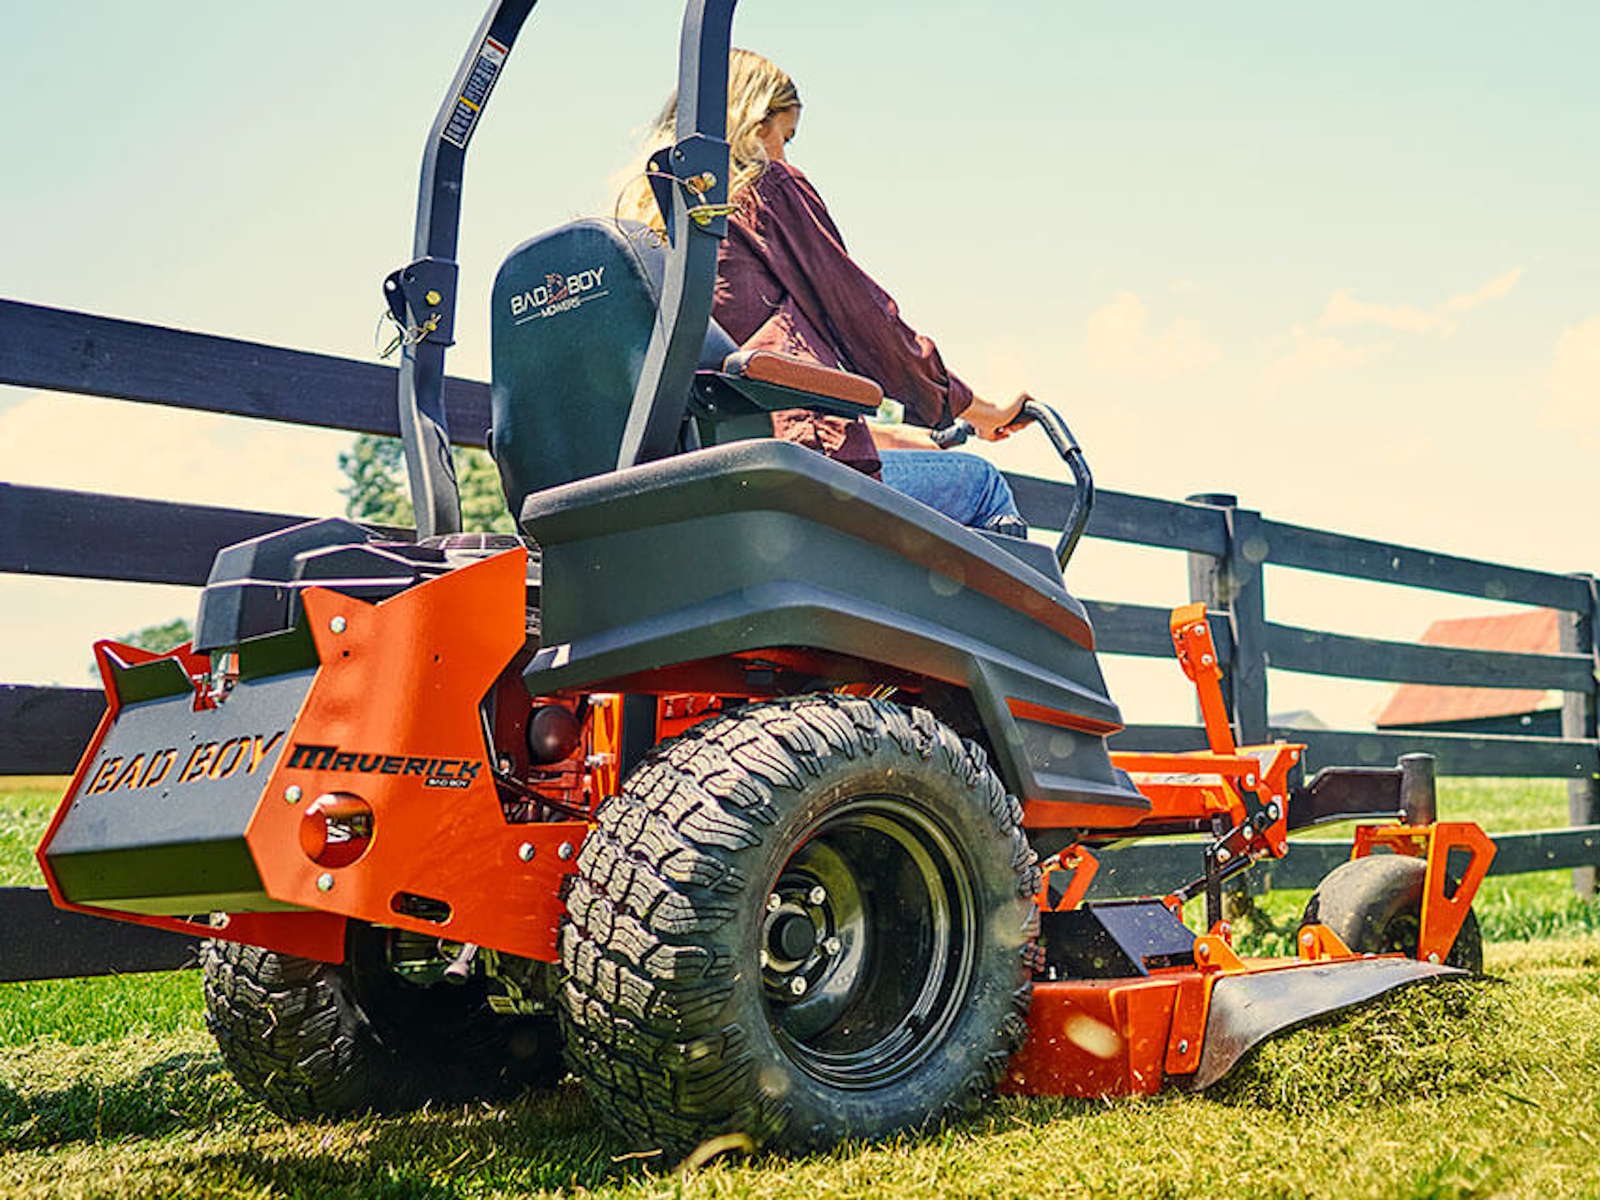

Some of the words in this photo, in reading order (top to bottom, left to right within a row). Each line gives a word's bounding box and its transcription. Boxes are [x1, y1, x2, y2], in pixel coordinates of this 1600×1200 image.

[511, 286, 548, 316] BAD
[566, 266, 605, 295] BOY
[86, 748, 179, 795] BAD
[177, 731, 285, 783] BOY
